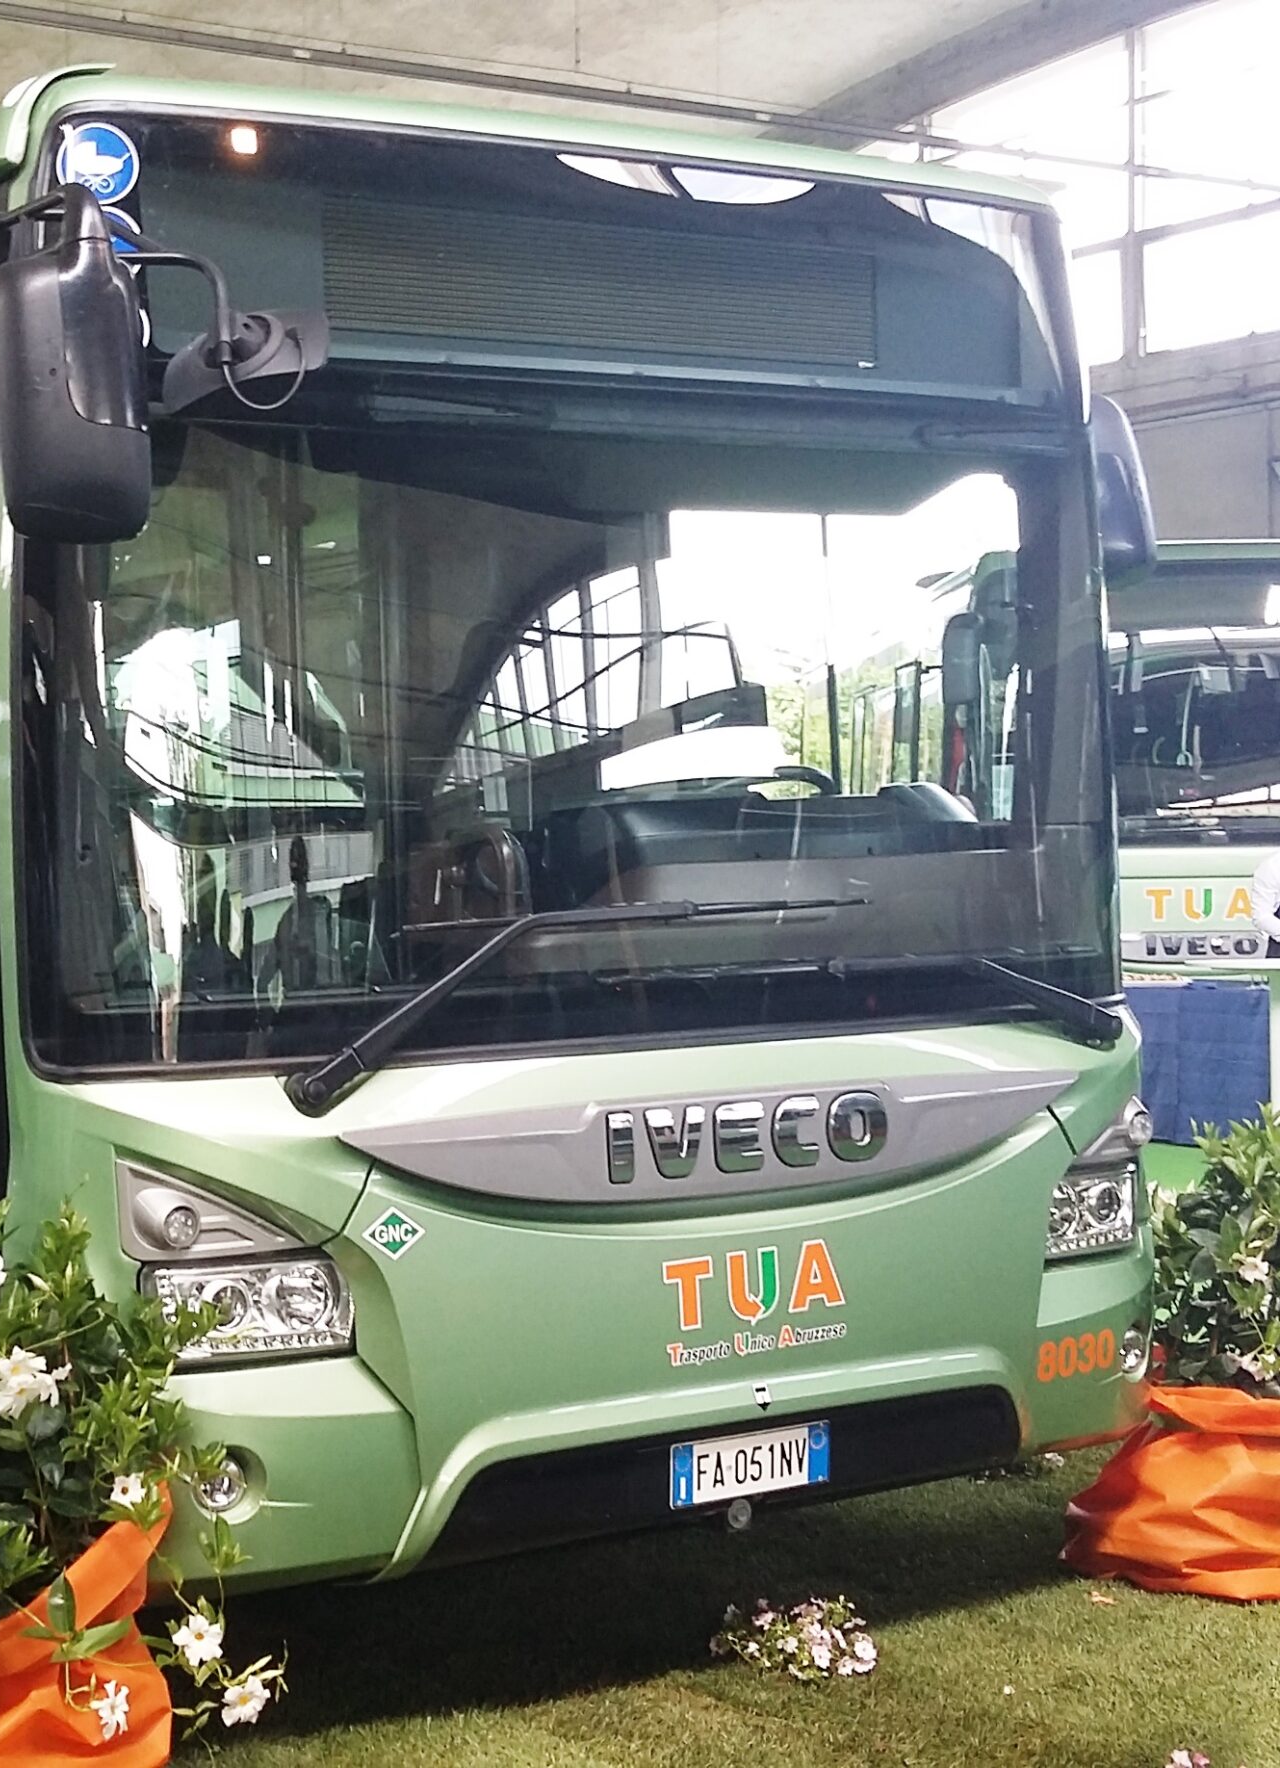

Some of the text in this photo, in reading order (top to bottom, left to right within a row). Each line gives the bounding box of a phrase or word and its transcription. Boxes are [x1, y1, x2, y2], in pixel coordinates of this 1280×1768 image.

[1145, 887, 1253, 920] TUA
[1145, 934, 1260, 957] IVECO
[606, 1089, 889, 1184] IVECO
[375, 1223, 413, 1243] GNC
[662, 1238, 846, 1331] TUA
[666, 1323, 848, 1366] Trasporto Unico Abruzzese
[1036, 1328, 1116, 1383] 8030
